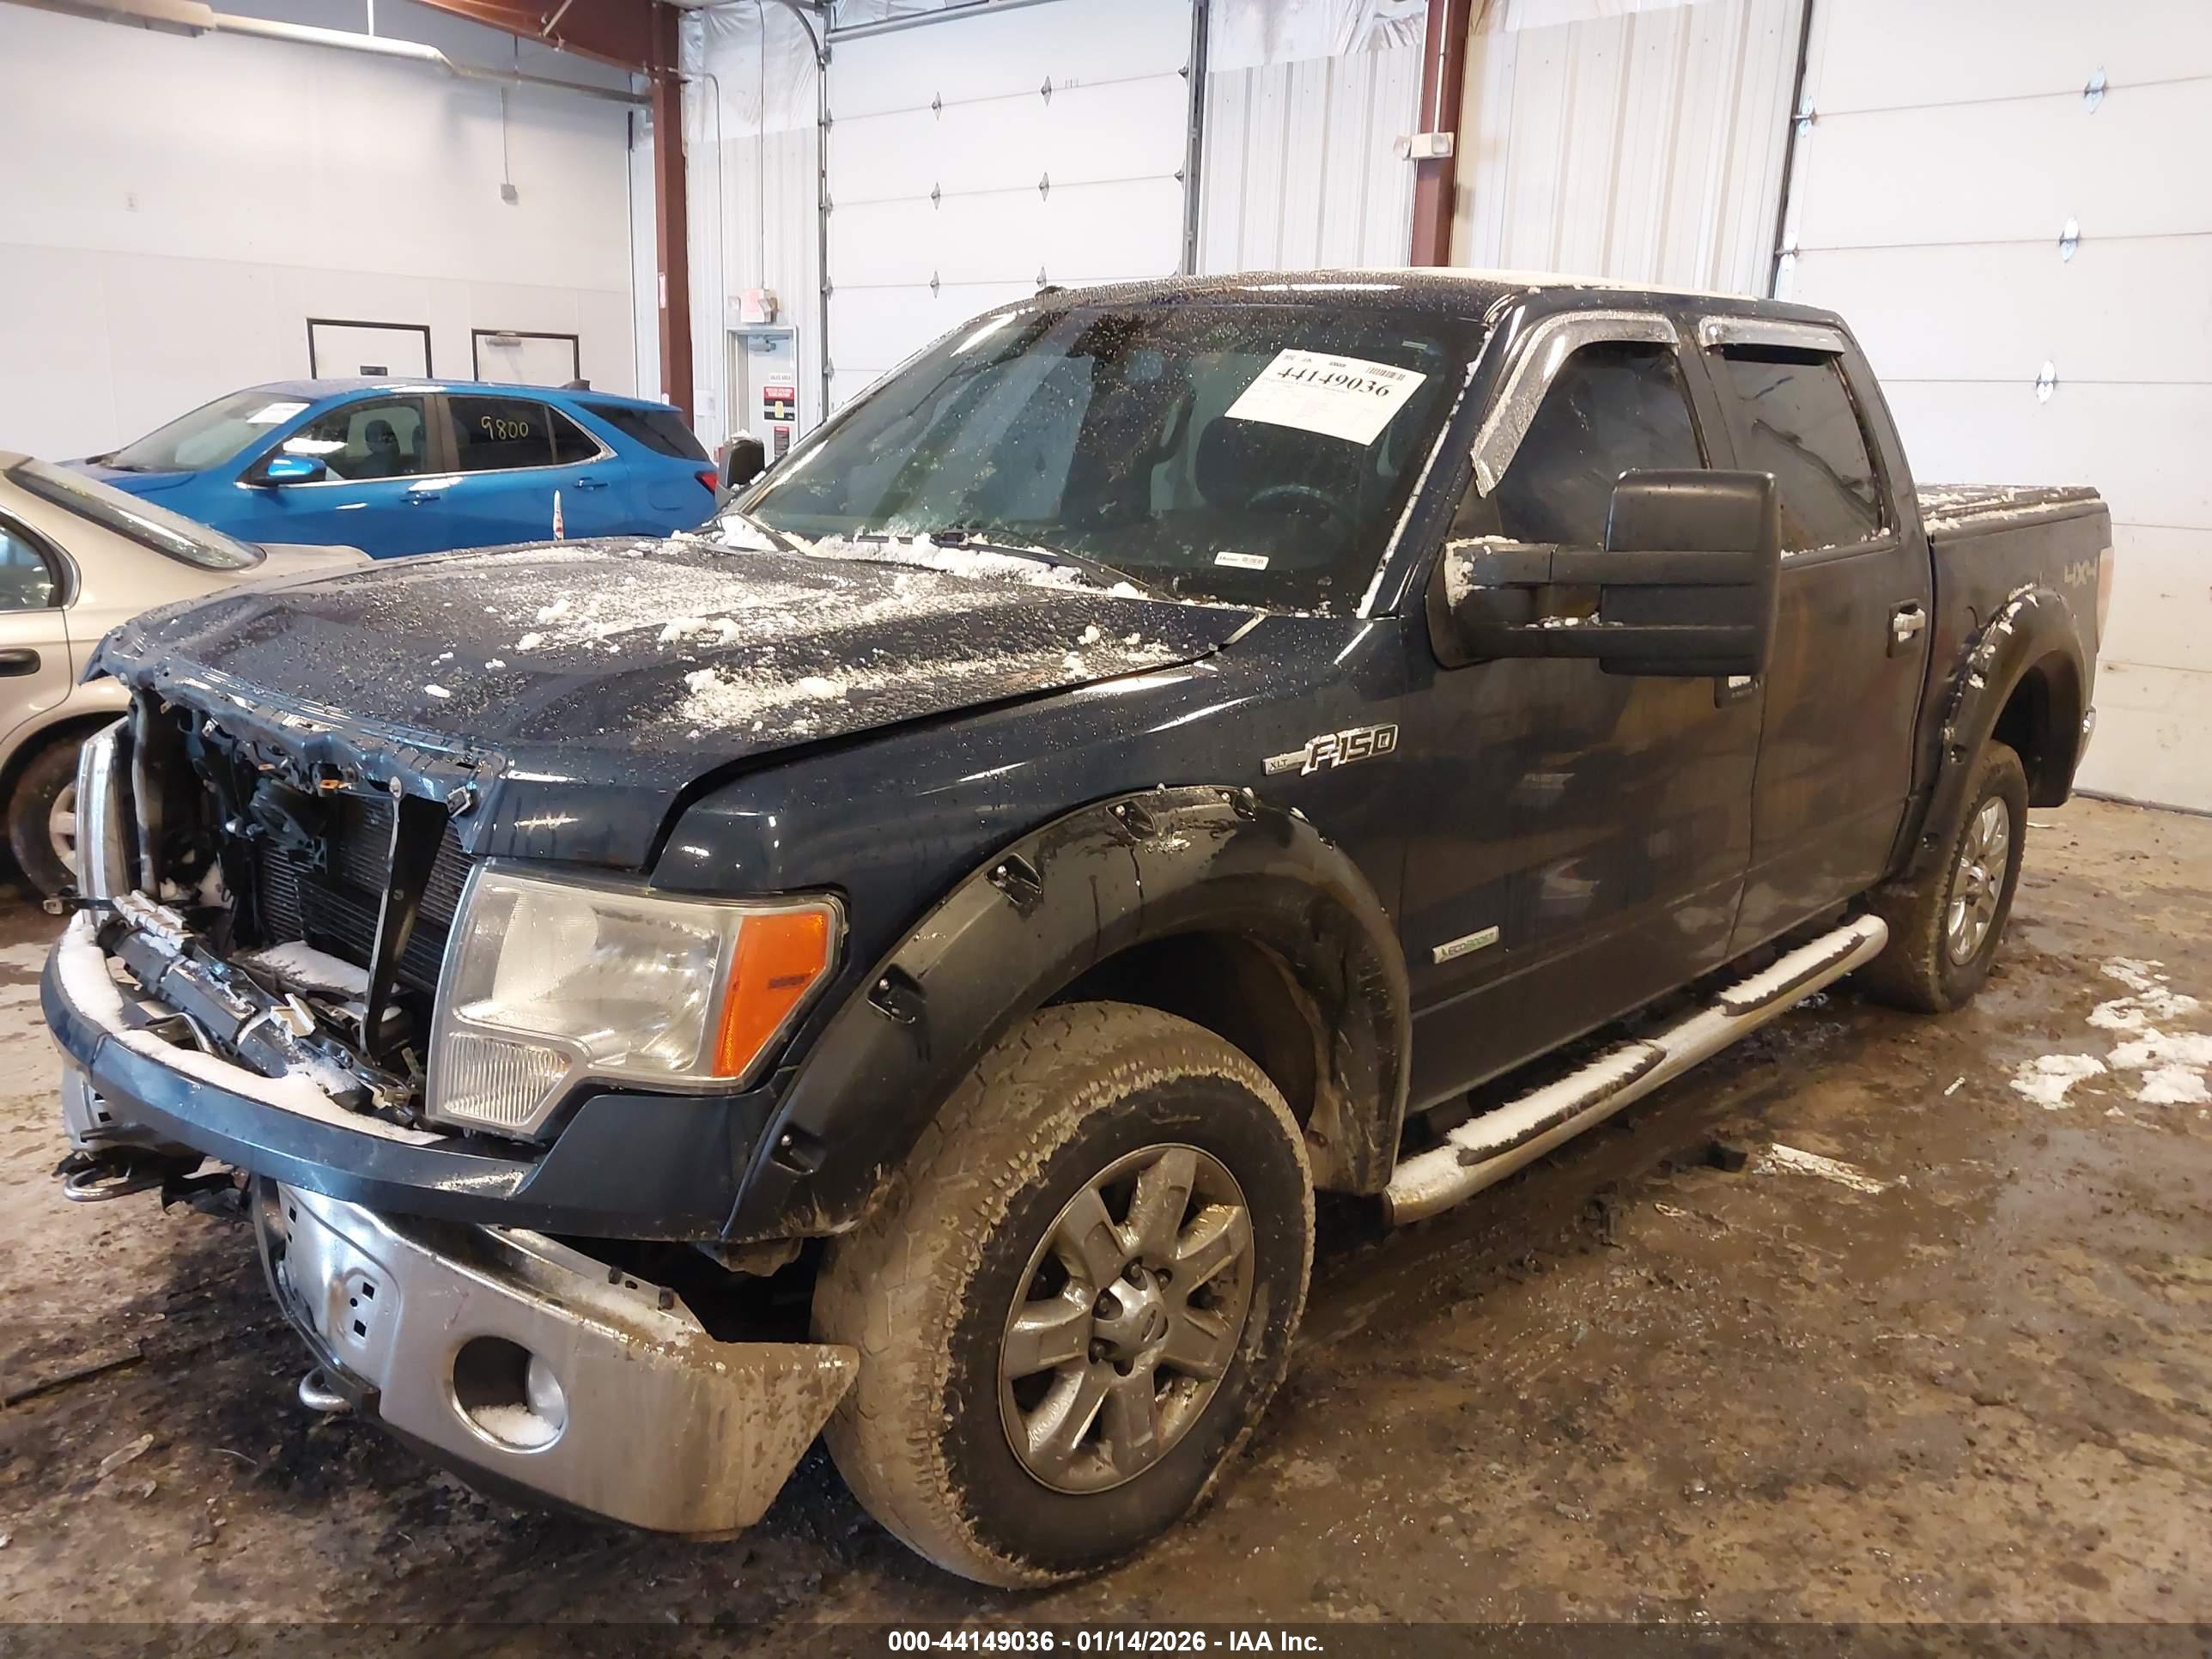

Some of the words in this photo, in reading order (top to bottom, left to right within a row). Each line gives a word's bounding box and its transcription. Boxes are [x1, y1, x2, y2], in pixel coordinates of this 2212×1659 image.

[1277, 367, 1394, 397] 44149036
[481, 416, 529, 440] 9800
[1269, 759, 1287, 770] XLT
